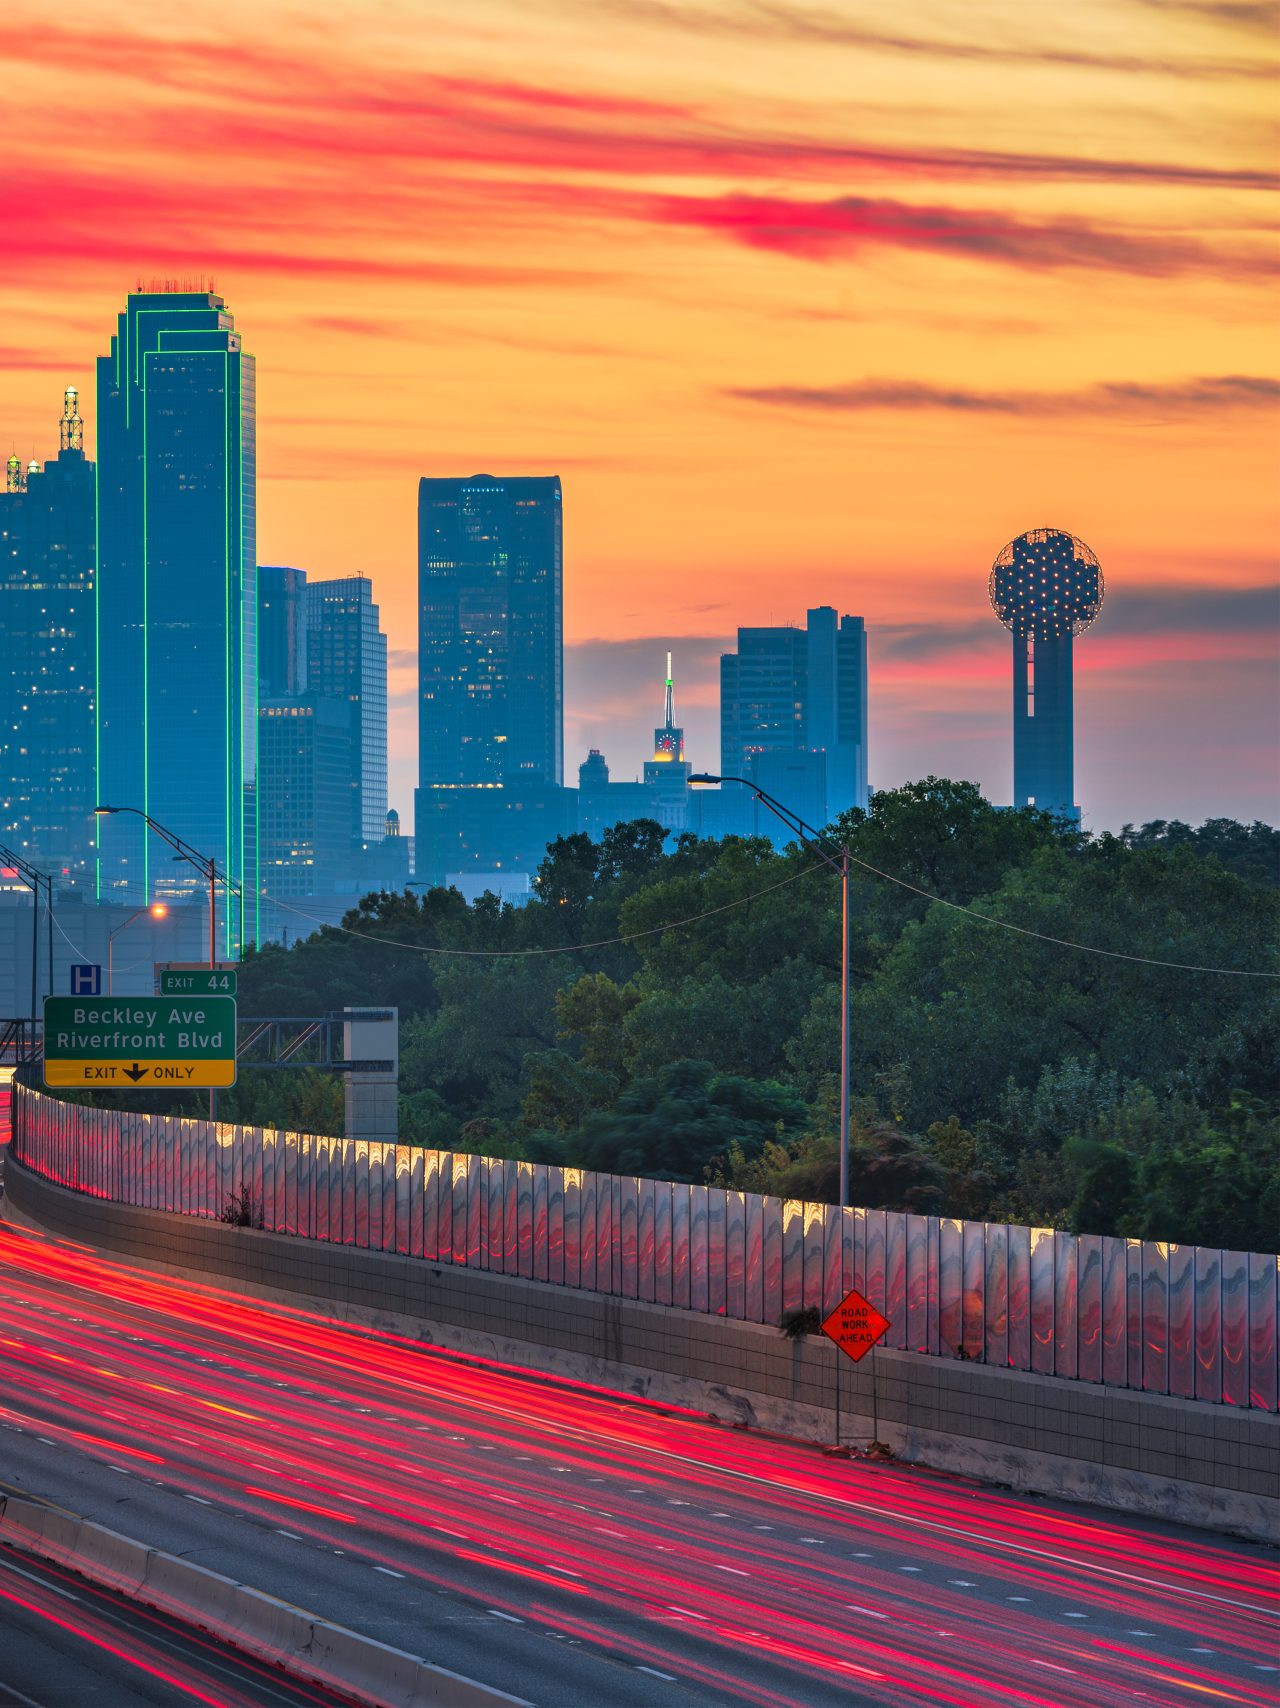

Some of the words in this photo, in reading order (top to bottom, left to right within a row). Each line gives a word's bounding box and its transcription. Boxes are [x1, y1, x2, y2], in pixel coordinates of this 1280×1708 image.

[75, 967, 97, 994] H
[167, 977, 195, 988] EXIT
[207, 975, 230, 990] 44
[74, 1008, 157, 1028] Beckley
[168, 1008, 206, 1024] Ave
[57, 1032, 166, 1048] Riverfront
[178, 1032, 222, 1048] Blvd
[84, 1067, 118, 1079] EXIT
[154, 1067, 195, 1079] ONLY
[841, 1308, 869, 1318] ROAD
[841, 1320, 869, 1330] WORK
[840, 1333, 873, 1343] AHEAD
